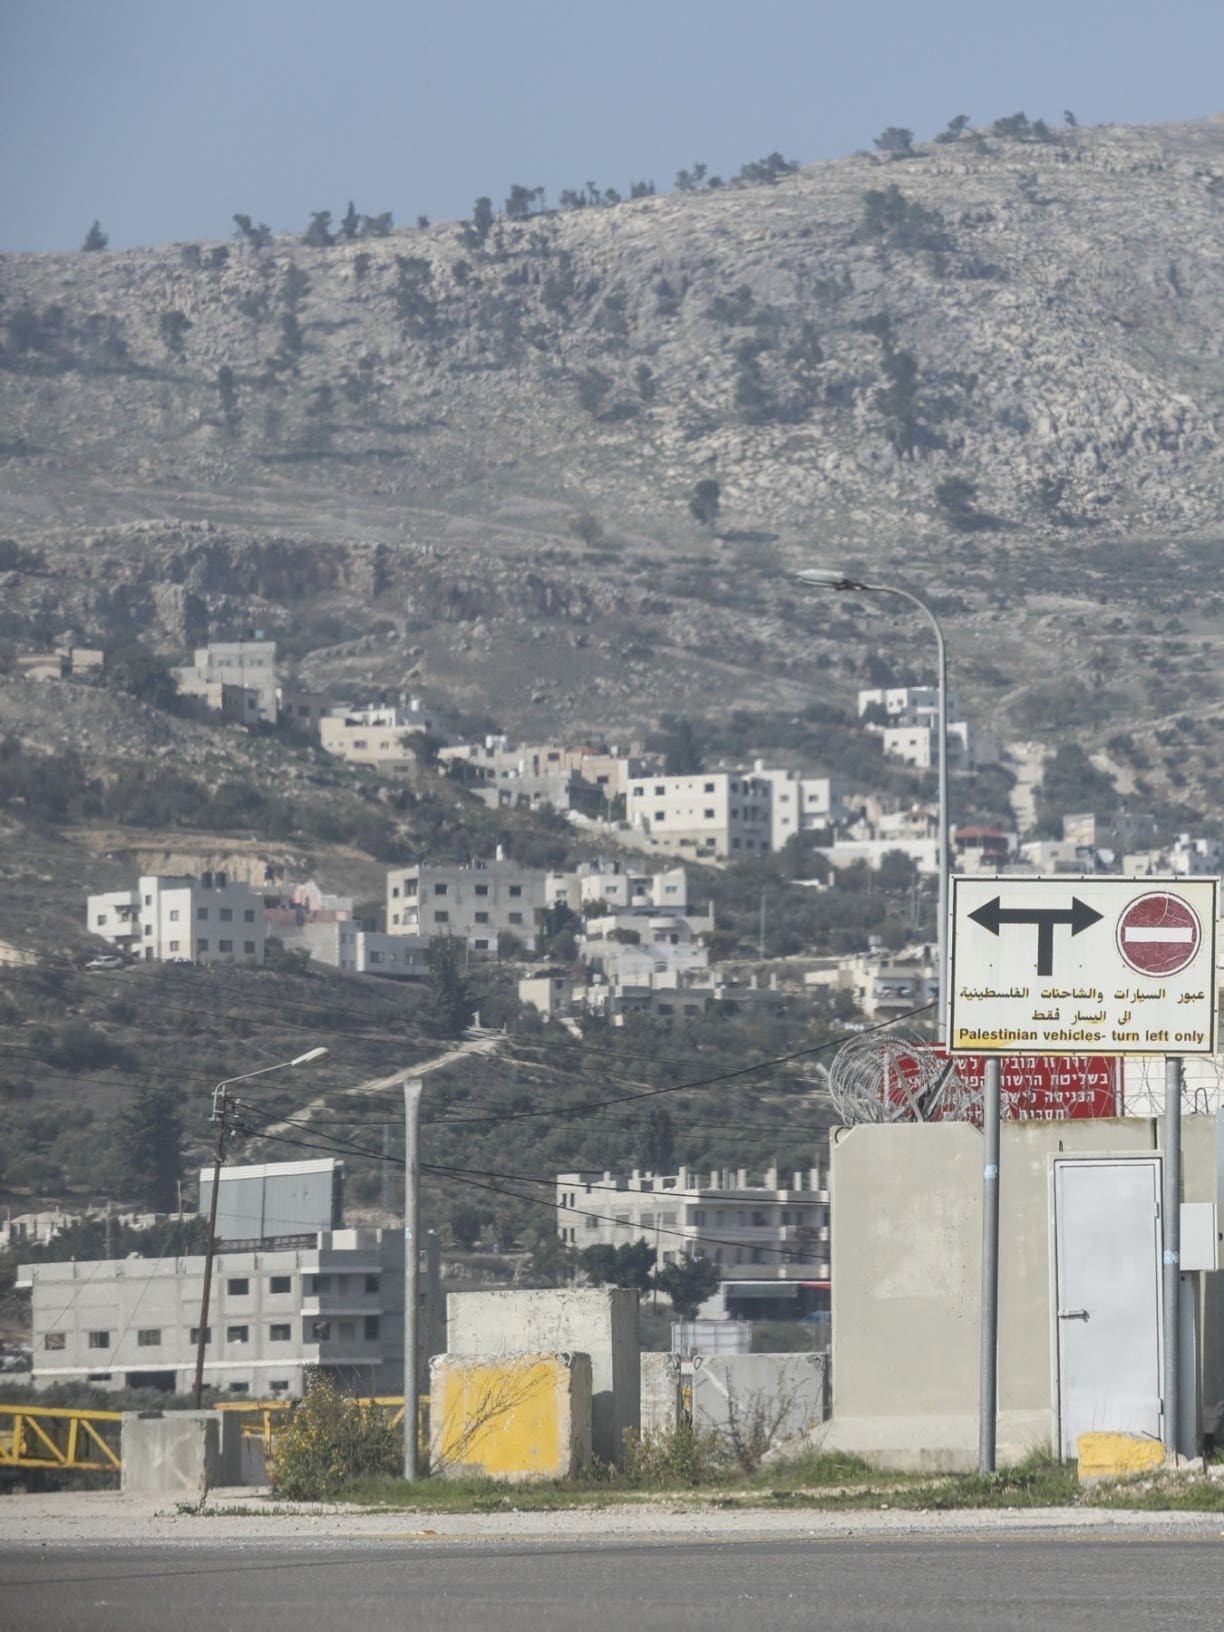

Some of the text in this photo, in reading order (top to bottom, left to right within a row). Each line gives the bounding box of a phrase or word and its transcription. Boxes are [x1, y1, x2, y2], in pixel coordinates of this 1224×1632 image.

[959, 987, 1205, 1004] عبور السيارات والشاحنات الفلسطينية
[1031, 1008, 1060, 1021] فقط
[1071, 1010, 1107, 1025] اليسار
[959, 1028, 1038, 1041] Palestinian
[1111, 1030, 1140, 1042] turn
[1145, 1029, 1169, 1042] left
[1174, 1029, 1204, 1044] only
